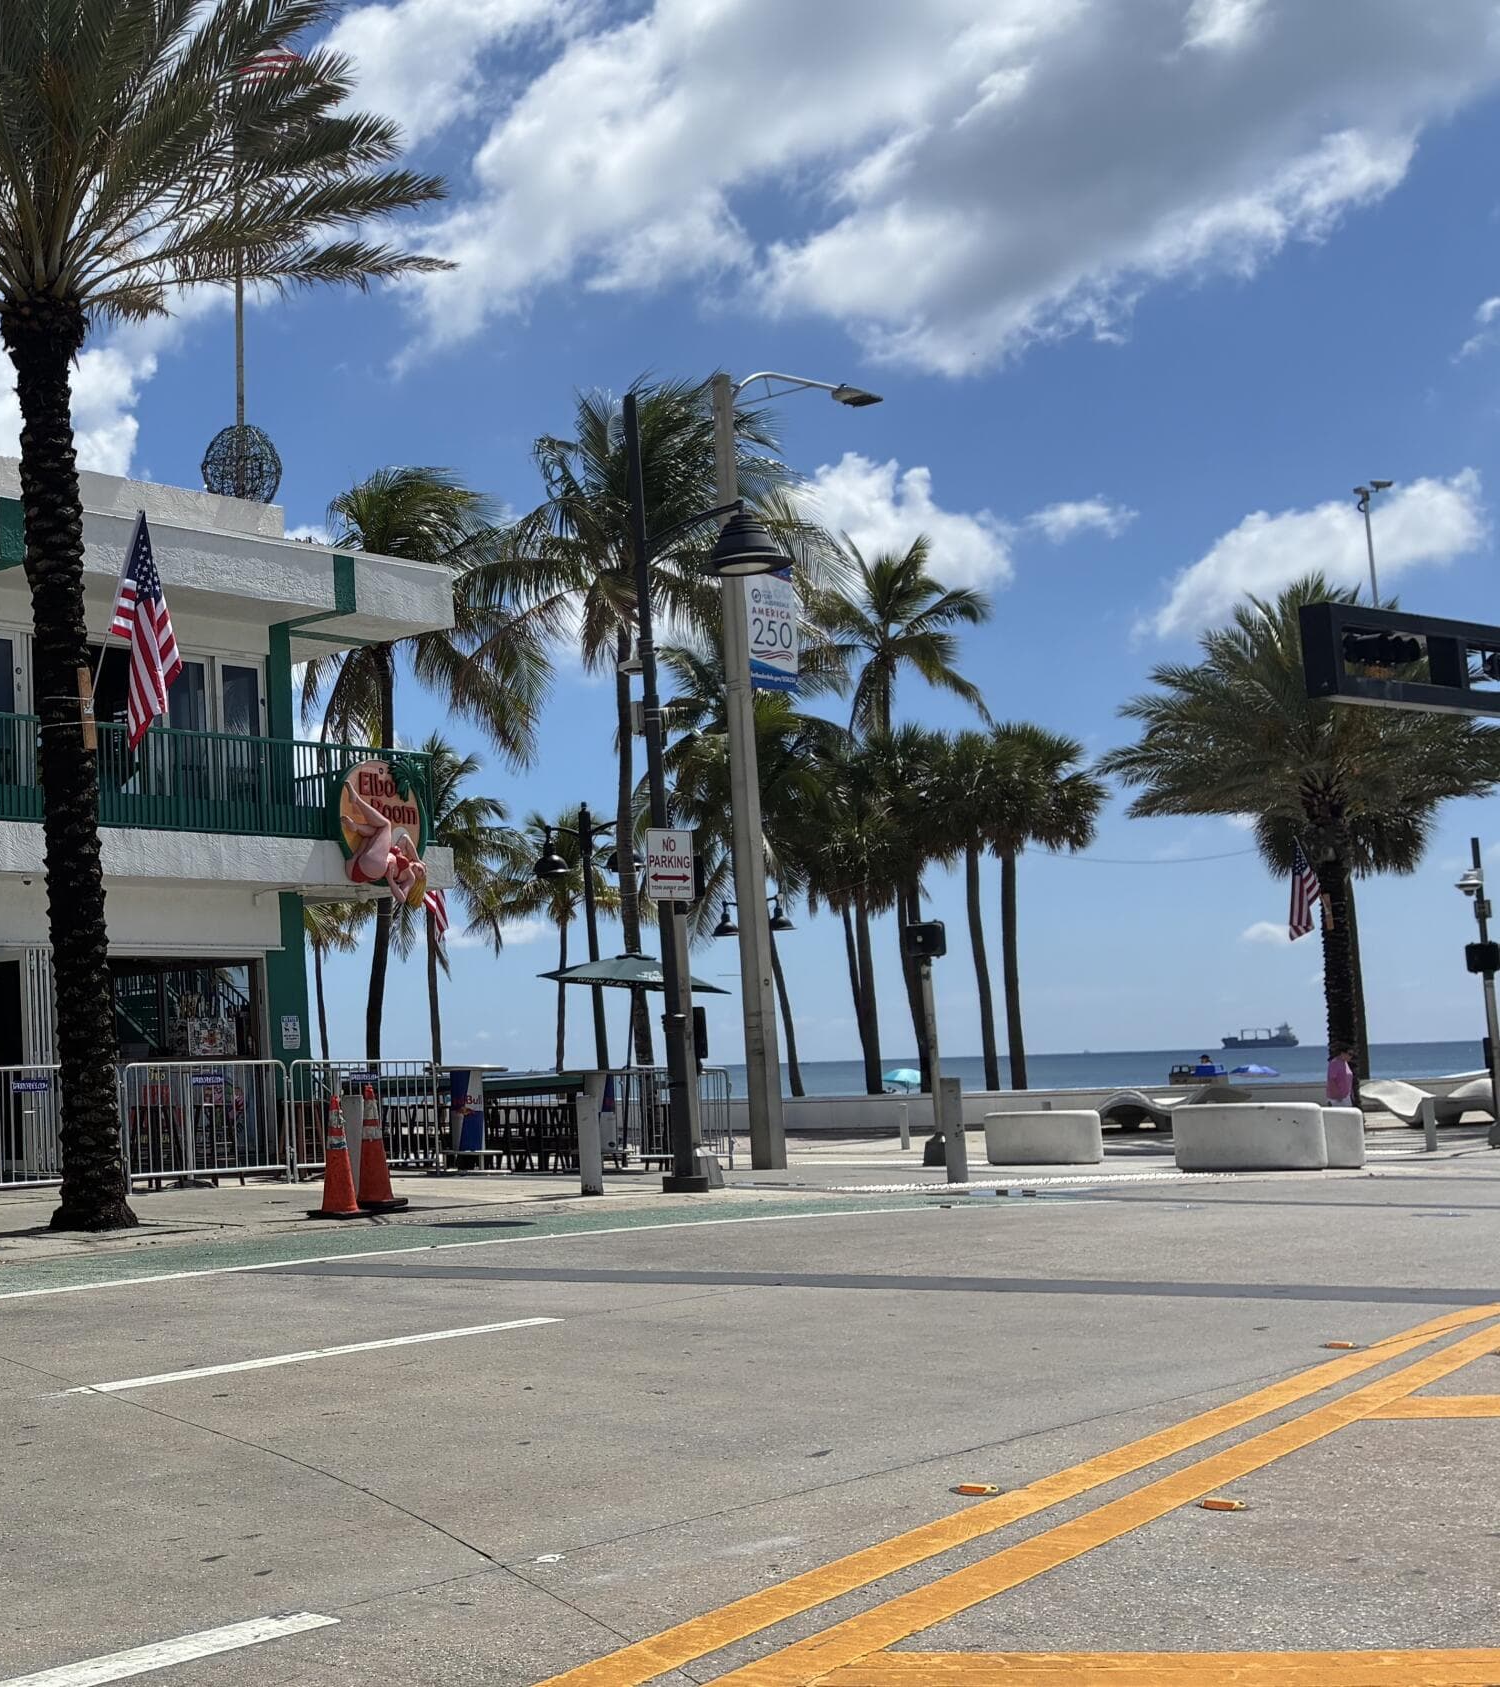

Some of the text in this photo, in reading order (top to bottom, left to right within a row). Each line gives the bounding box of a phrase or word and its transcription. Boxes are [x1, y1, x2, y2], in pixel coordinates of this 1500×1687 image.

[752, 606, 791, 620] AMERICA
[752, 618, 792, 649] 250
[359, 772, 397, 797] Elbo
[662, 838, 676, 852] NO
[649, 855, 691, 869] PARKING
